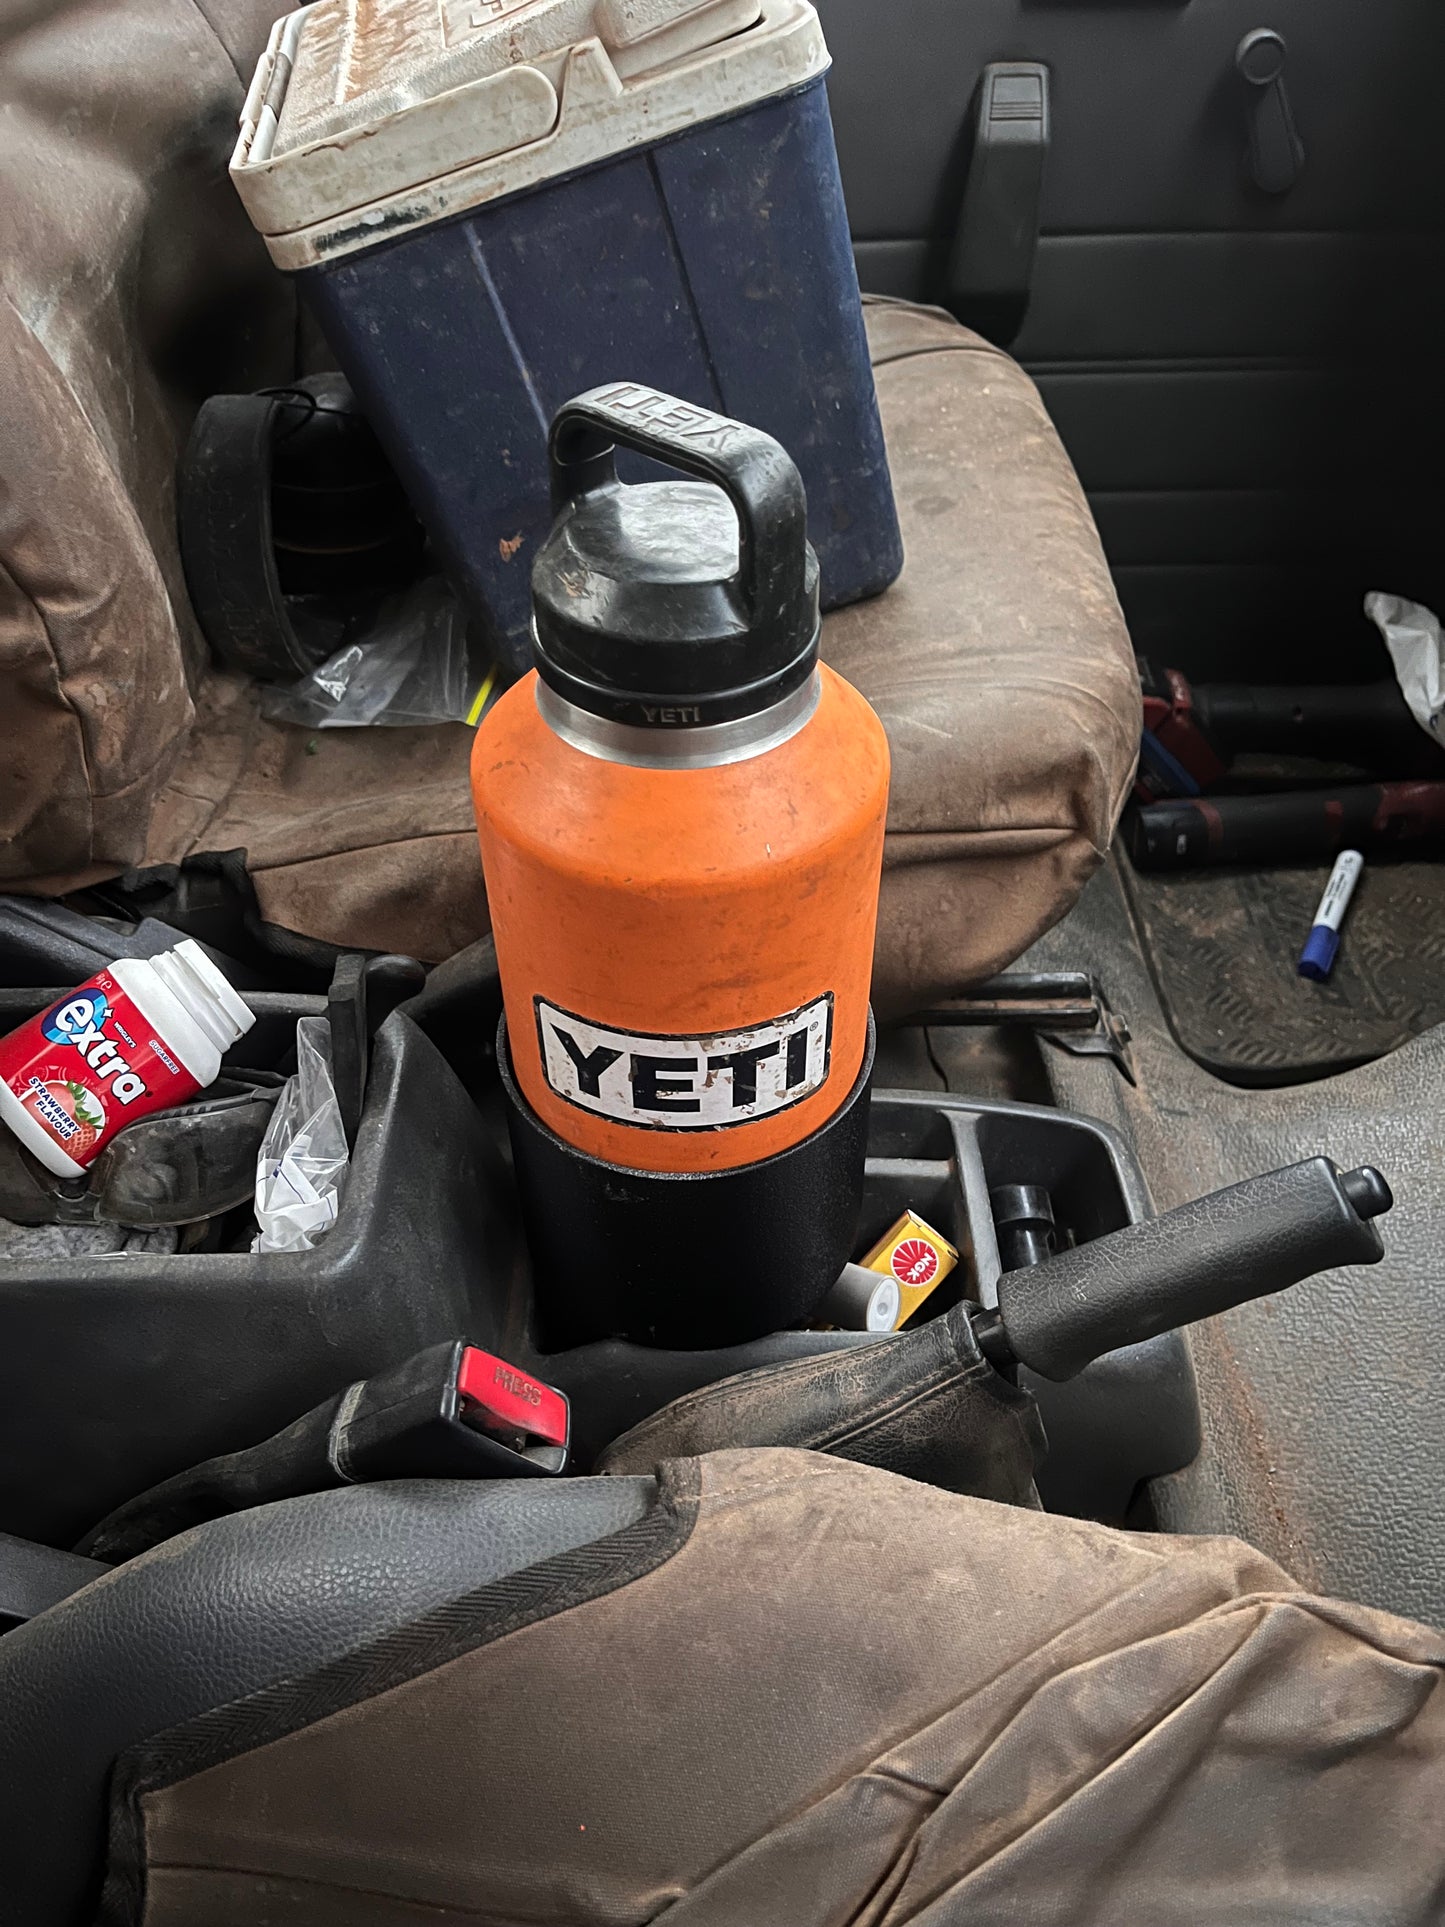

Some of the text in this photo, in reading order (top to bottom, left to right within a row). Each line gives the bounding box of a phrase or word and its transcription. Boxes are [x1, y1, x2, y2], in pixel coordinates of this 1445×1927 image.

[594, 386, 740, 451] YETI
[640, 705, 700, 723] YETI
[55, 998, 147, 1106] extra
[149, 1040, 179, 1074] SUGARFREE
[549, 1023, 809, 1113] YETI
[30, 1077, 80, 1133] STRAWBERRY
[35, 1100, 72, 1139] FLAVOUR
[907, 1252, 933, 1281] NGK
[493, 1366, 542, 1407] PRESS
